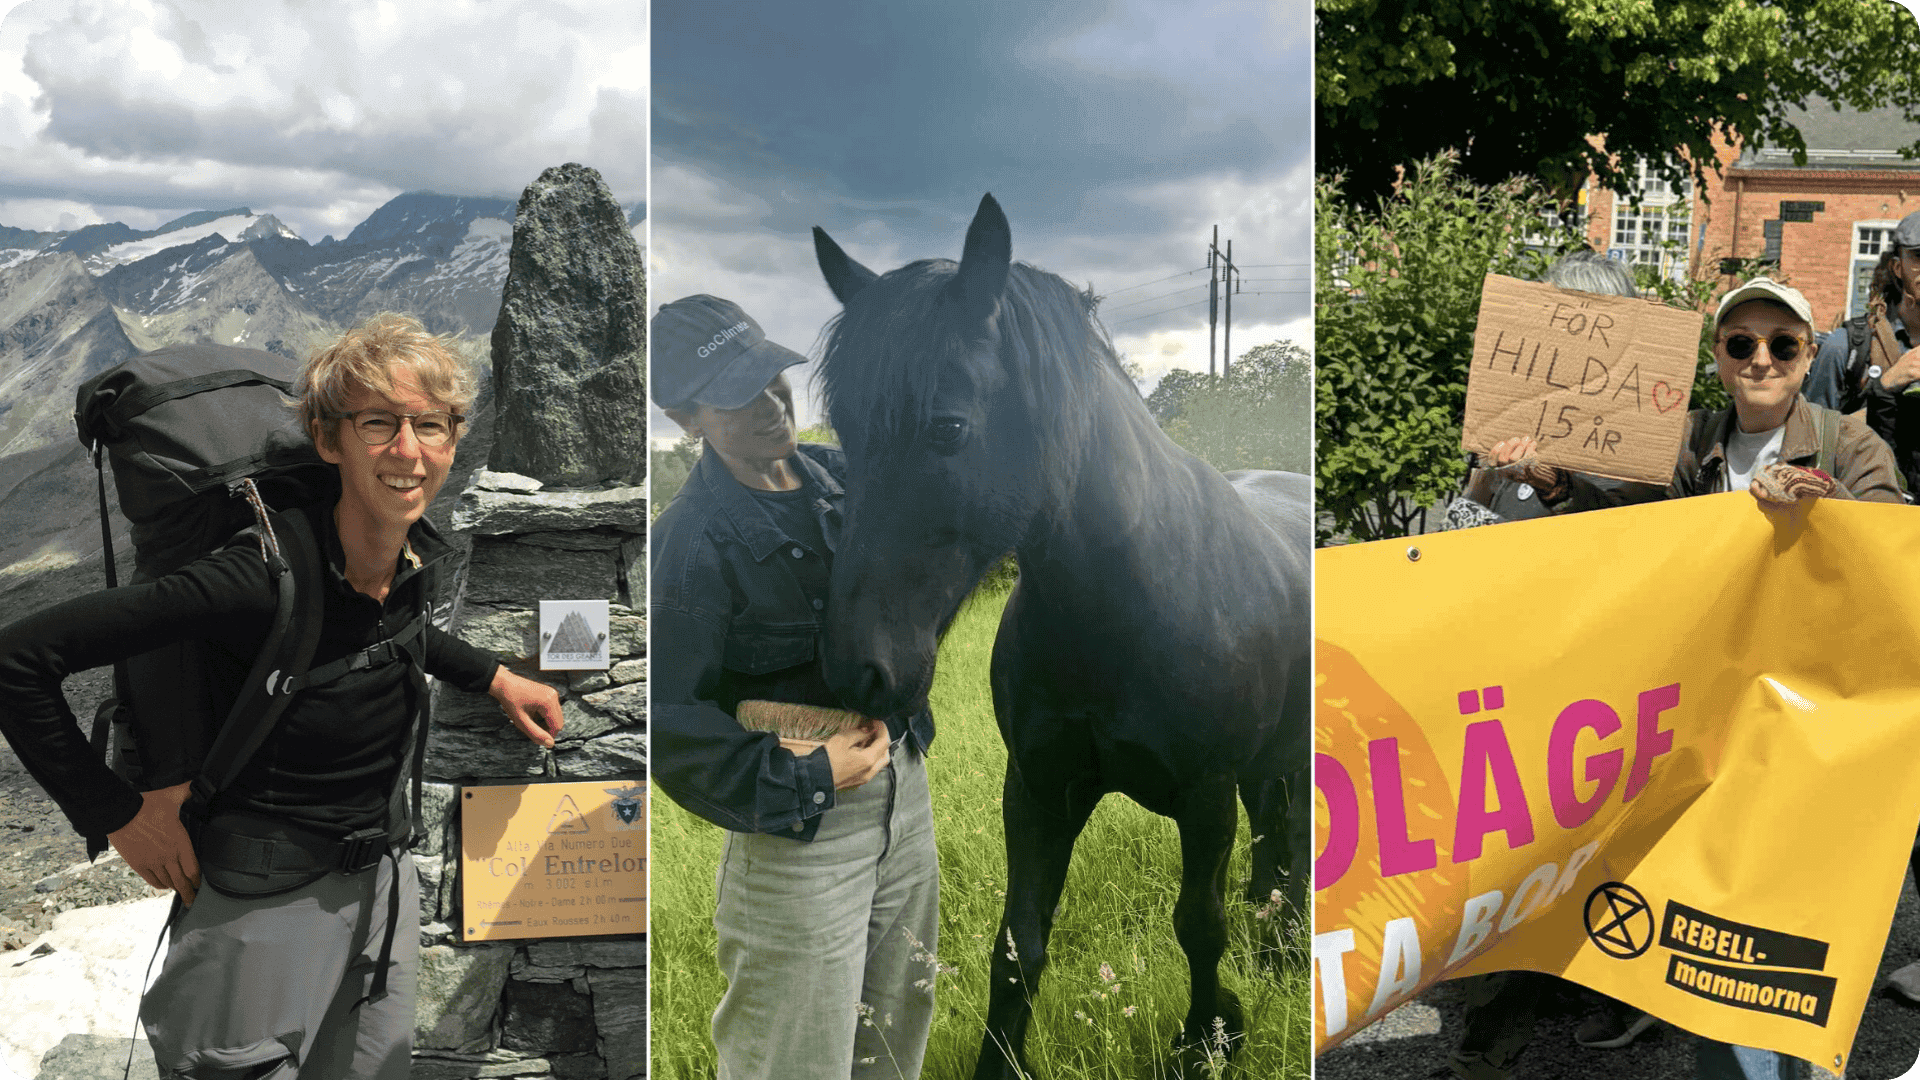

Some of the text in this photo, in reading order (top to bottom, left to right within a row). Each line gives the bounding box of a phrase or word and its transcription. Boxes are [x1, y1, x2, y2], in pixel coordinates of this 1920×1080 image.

[1549, 302, 1615, 349] FÖR
[1488, 330, 1641, 413] HILDA
[1582, 415, 1623, 455] ÅR
[506, 836, 632, 852] Alta Via Numero Due
[552, 916, 590, 926] Rousses
[1670, 913, 1768, 964] REBELL-
[1674, 960, 1818, 1017] mammorna
